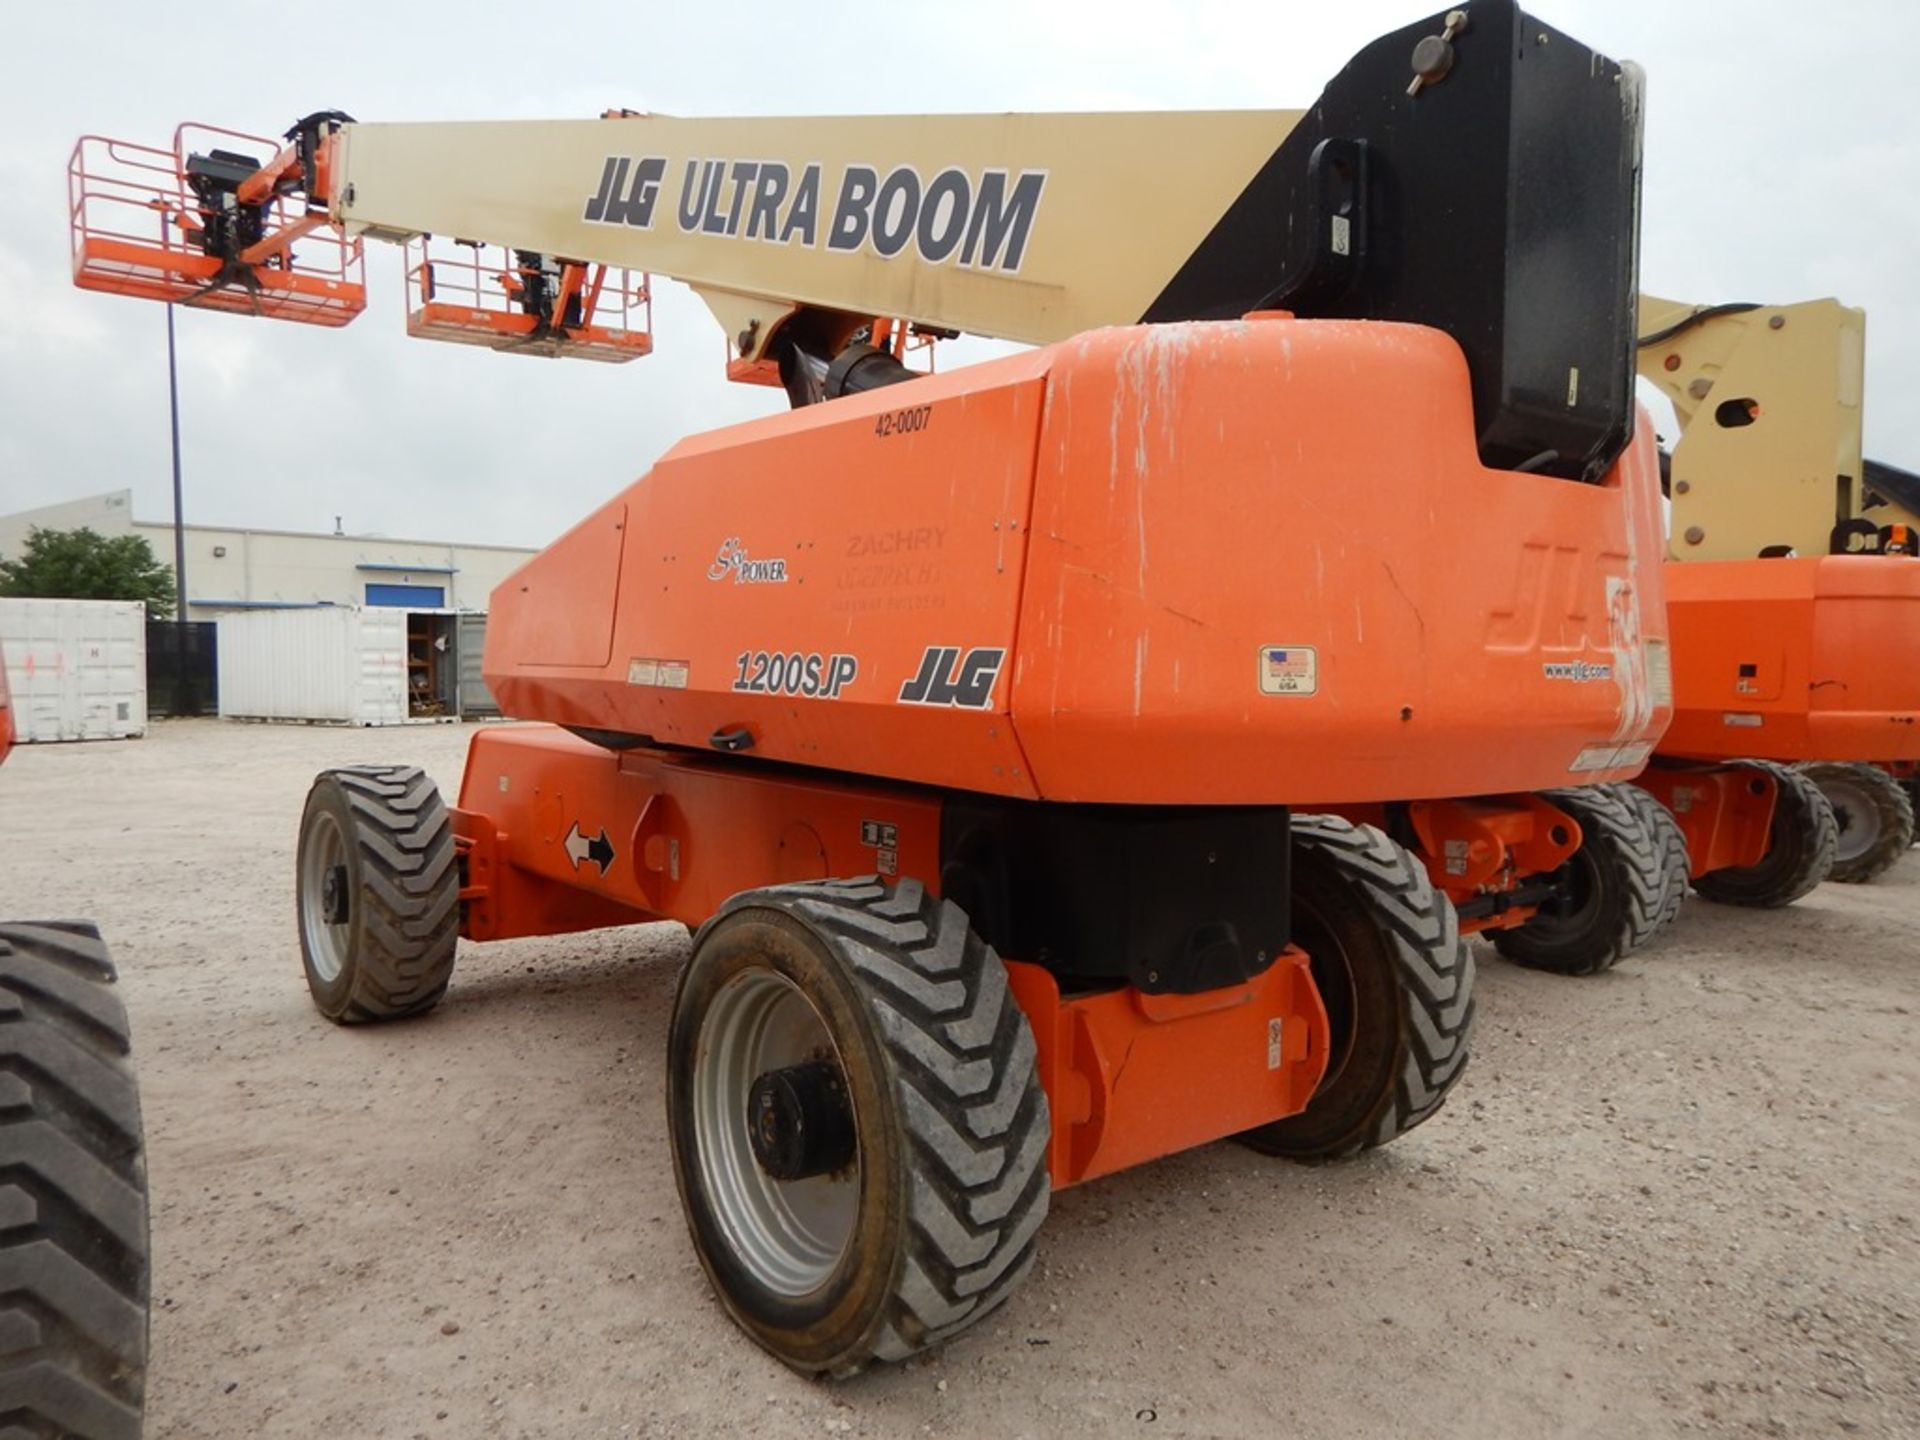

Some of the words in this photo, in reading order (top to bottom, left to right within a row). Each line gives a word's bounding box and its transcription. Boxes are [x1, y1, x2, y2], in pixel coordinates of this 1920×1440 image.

[583, 156, 667, 228] JLG
[678, 159, 821, 246] ULTRA
[826, 164, 1047, 273] BOOM
[875, 406, 932, 437] 42-0007
[845, 523, 948, 557] ZACHRY
[742, 559, 786, 583] POWER
[732, 651, 857, 699] 1200SJP
[897, 647, 1006, 710] JLG
[1544, 661, 1611, 682] www.jlg.com
